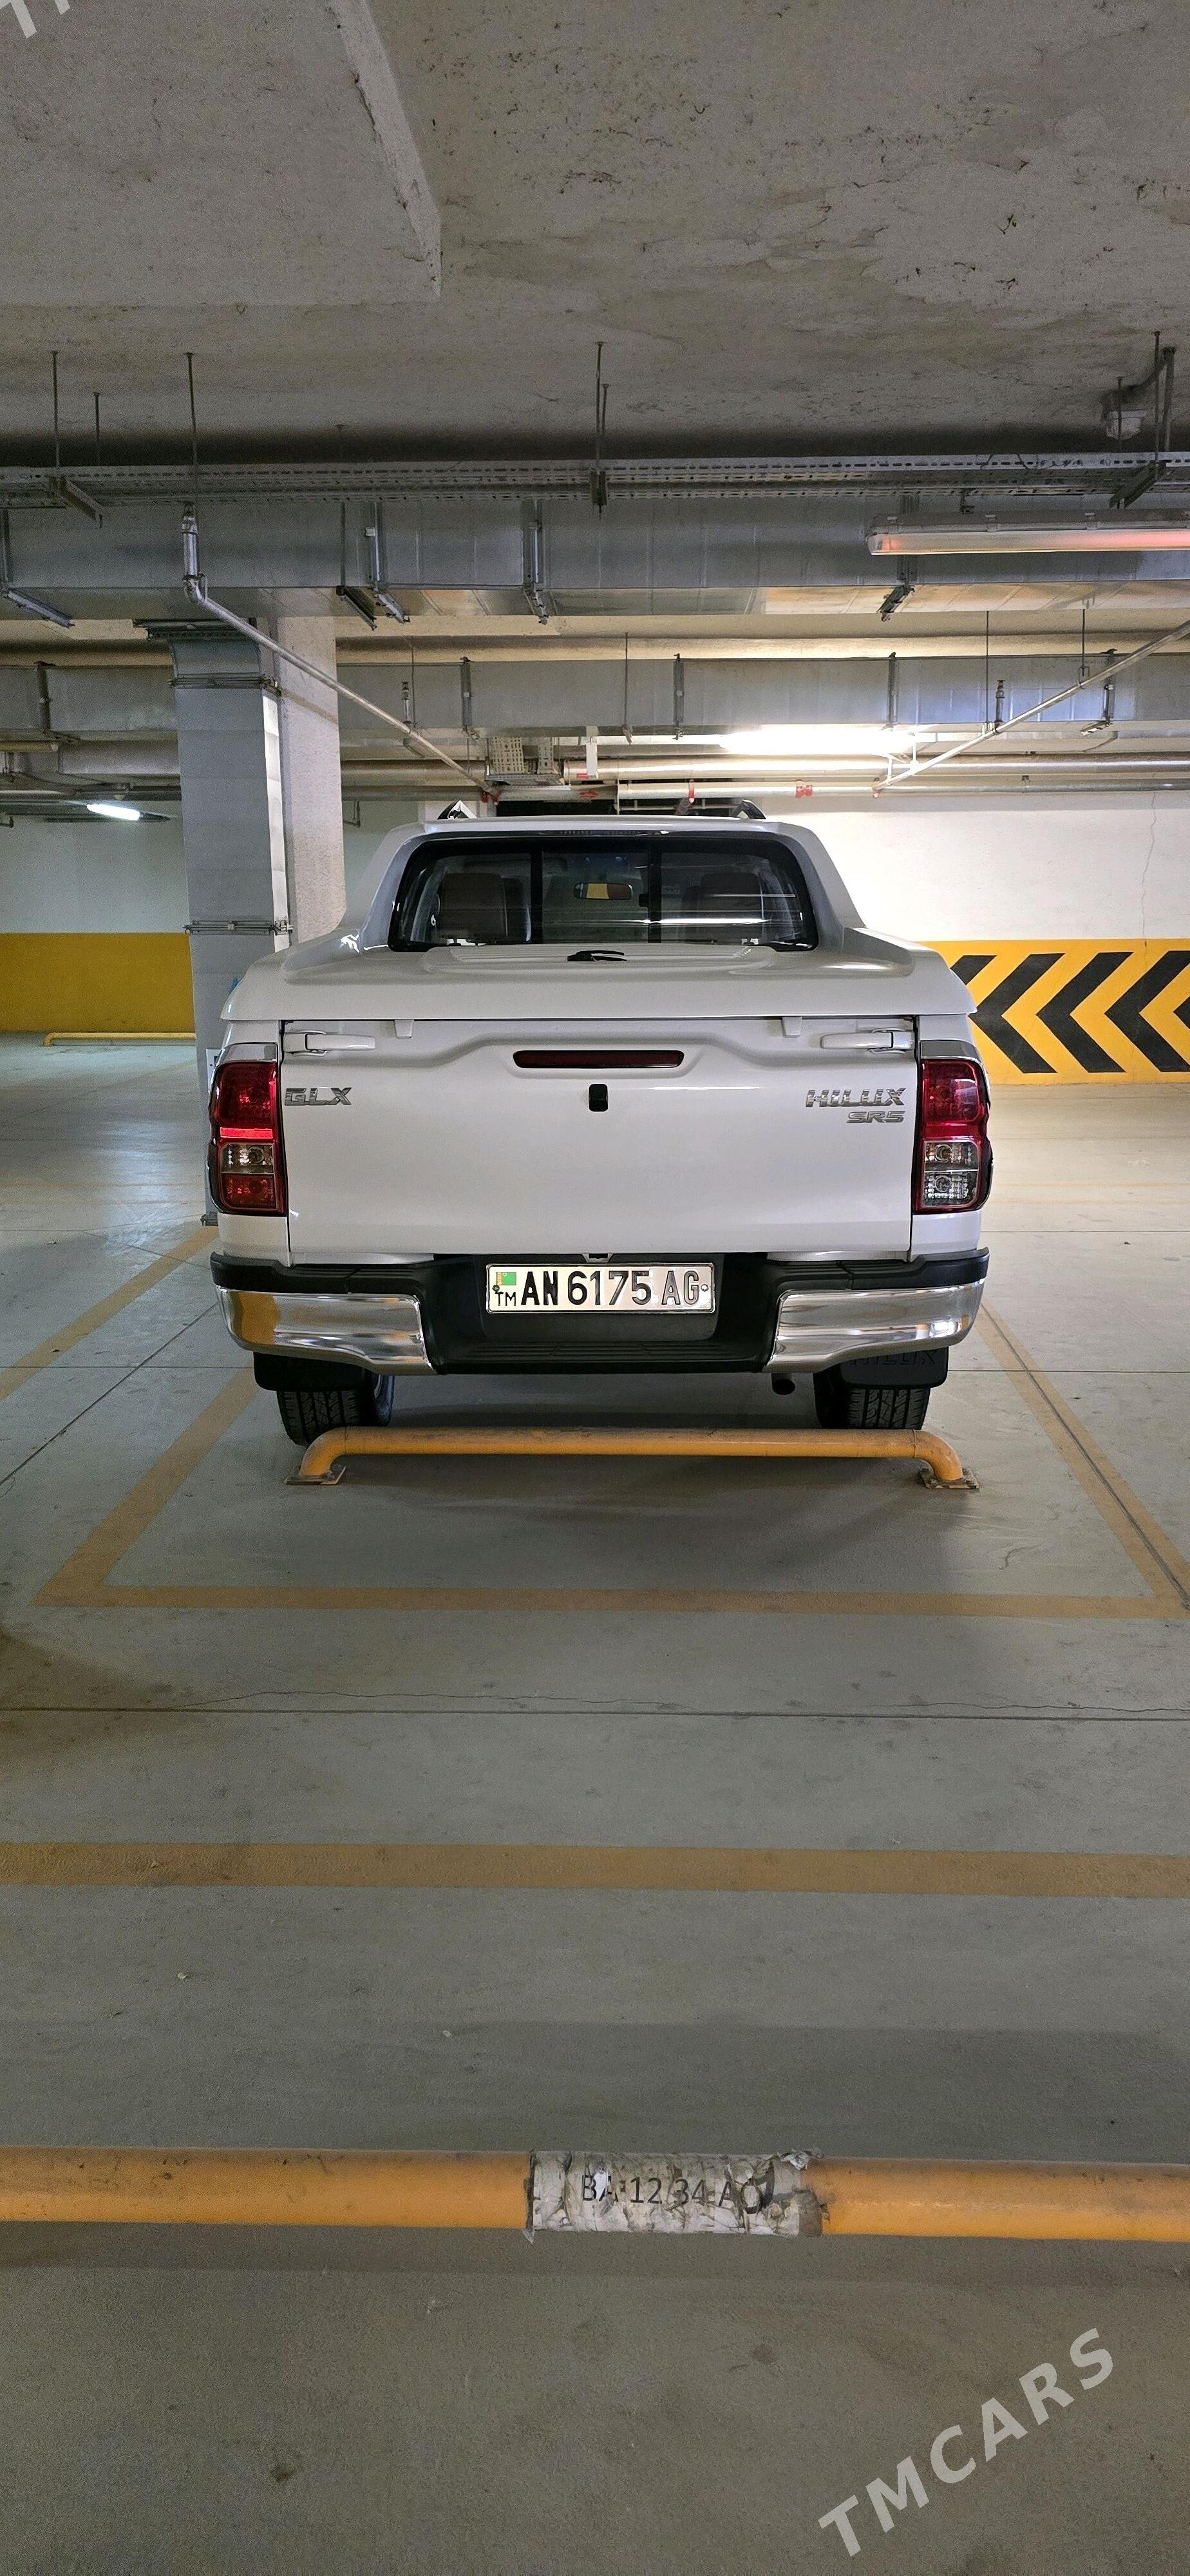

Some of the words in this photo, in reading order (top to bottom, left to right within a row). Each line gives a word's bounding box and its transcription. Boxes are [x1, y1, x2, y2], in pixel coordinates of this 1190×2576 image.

[285, 1088, 352, 1106] GLX
[806, 1088, 906, 1107] HILUX
[846, 1111, 905, 1123] SR5
[495, 1291, 516, 1306] TM
[521, 1271, 558, 1305] AN
[567, 1271, 652, 1305] 6175
[661, 1271, 699, 1305] AG
